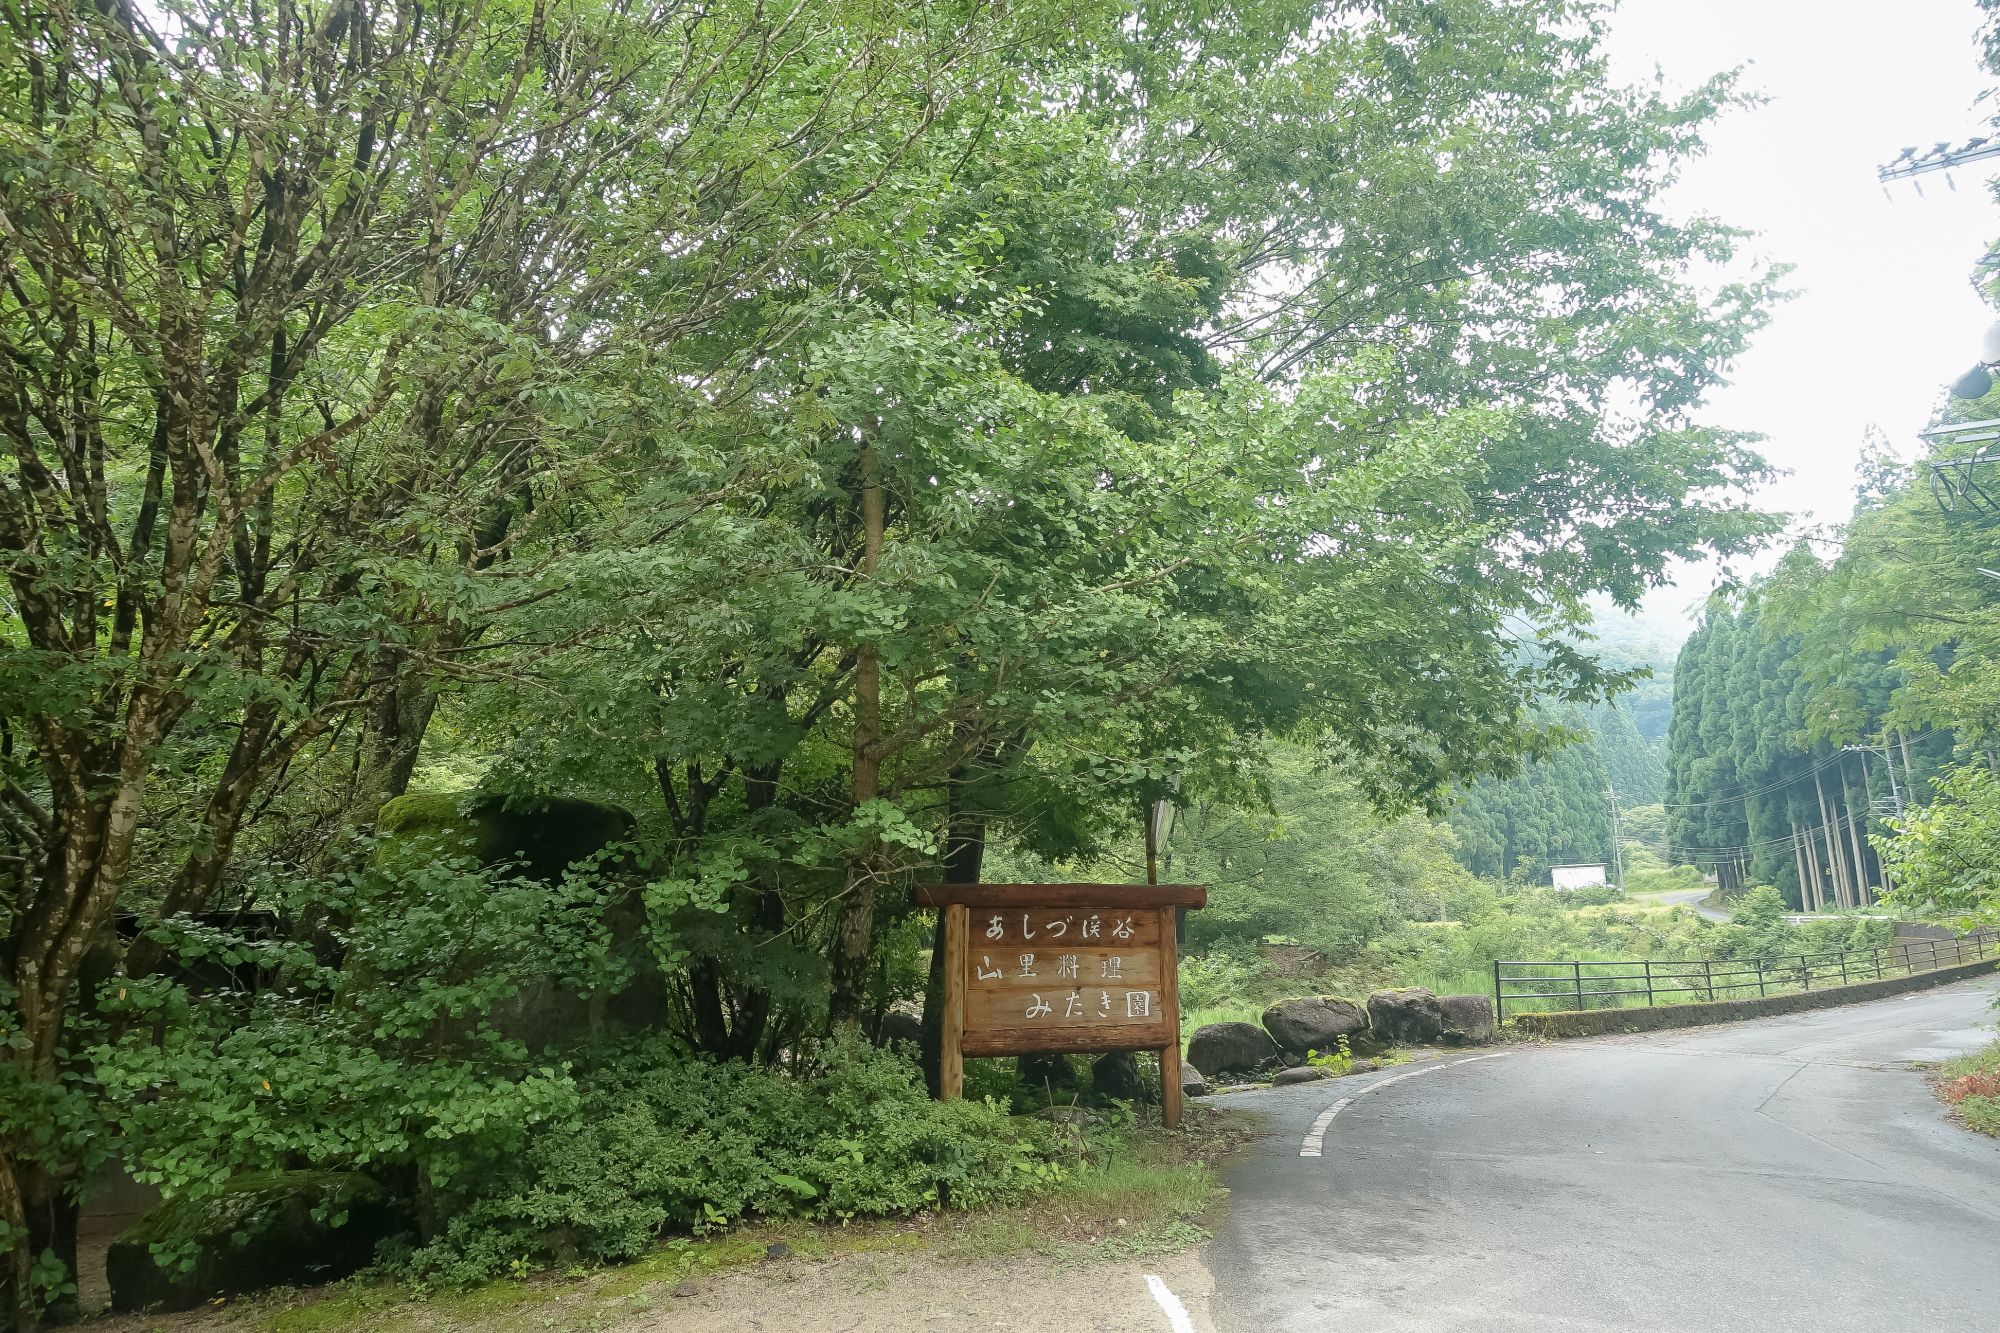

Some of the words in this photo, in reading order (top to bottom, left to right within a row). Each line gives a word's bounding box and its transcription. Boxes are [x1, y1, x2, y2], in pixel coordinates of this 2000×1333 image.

[986, 914, 1135, 940] あしづ渓谷
[977, 953, 1122, 981] 山里料理
[1025, 990, 1150, 1019] みたき園
